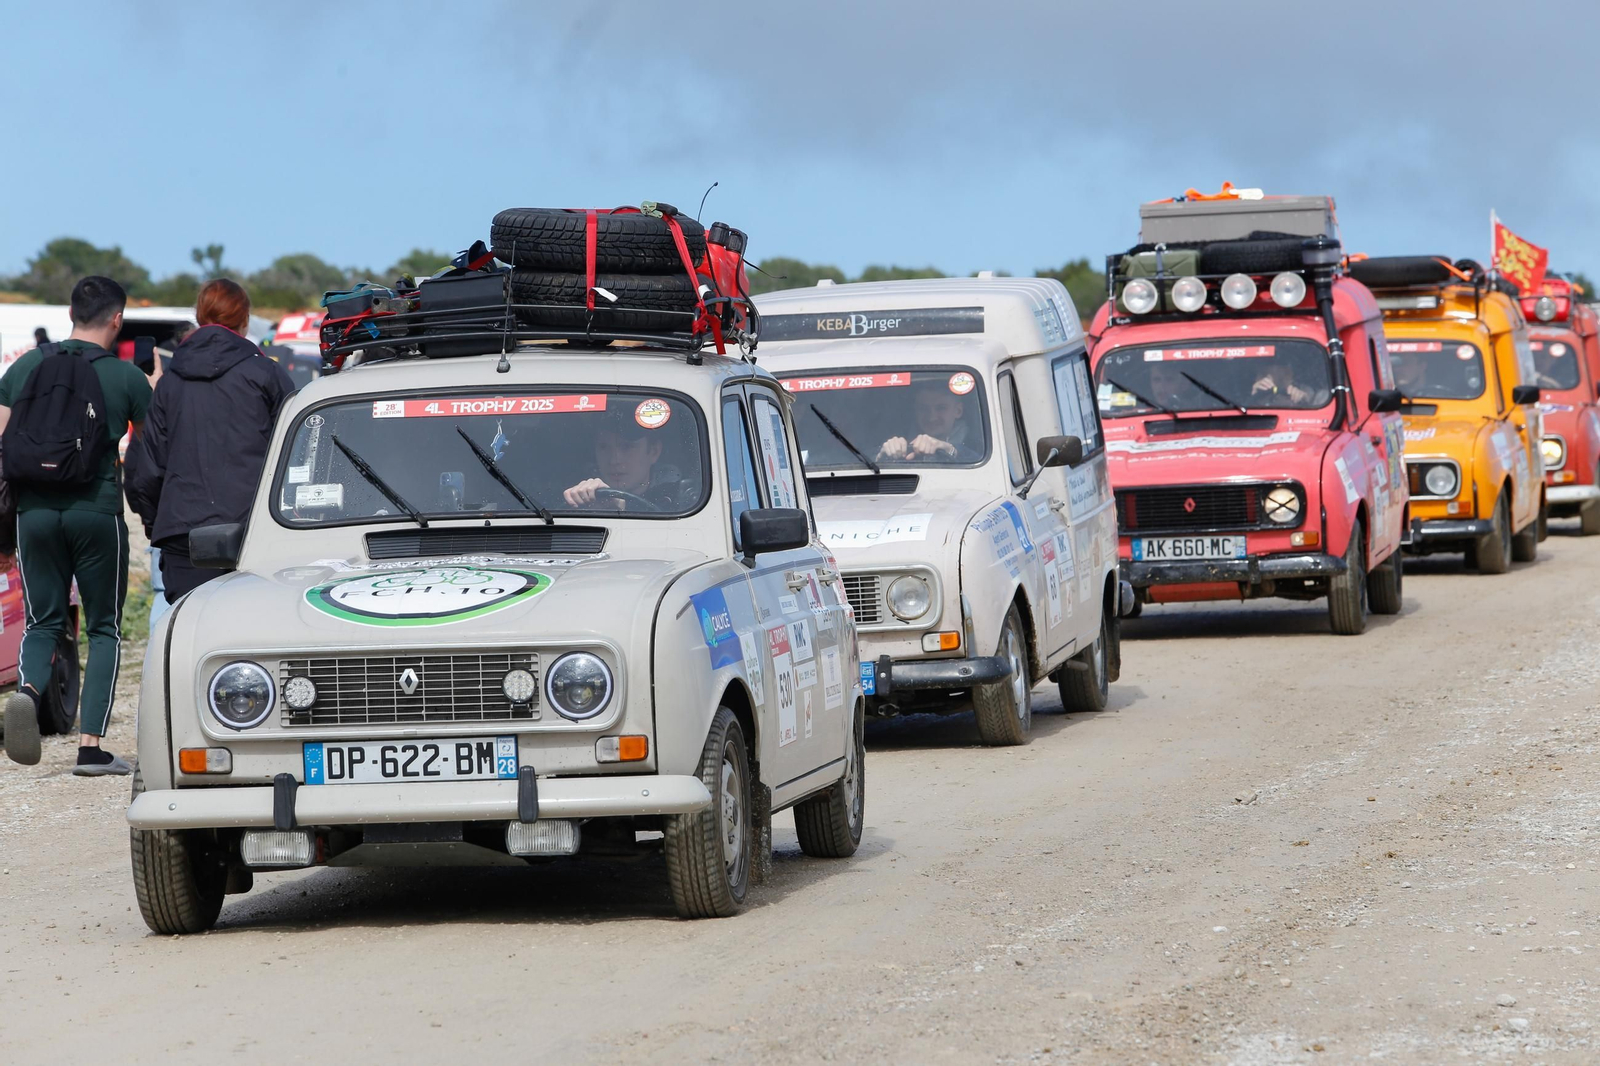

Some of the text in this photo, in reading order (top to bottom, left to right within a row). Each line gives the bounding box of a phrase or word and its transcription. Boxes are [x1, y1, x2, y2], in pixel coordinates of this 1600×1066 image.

[1188, 350, 1223, 359] TROPHY
[1226, 348, 1246, 357] 2025
[798, 378, 845, 389] TROPHY
[848, 376, 873, 387] 2025
[424, 402, 444, 414] 4L
[450, 399, 515, 413] TROPHY
[520, 398, 555, 411] 2025
[1147, 538, 1231, 557] AK-660-MC
[779, 670, 793, 709] 530
[862, 679, 873, 690] 54
[327, 741, 495, 779] DP-622-BM
[498, 758, 516, 775] 28
[311, 768, 318, 778] F
